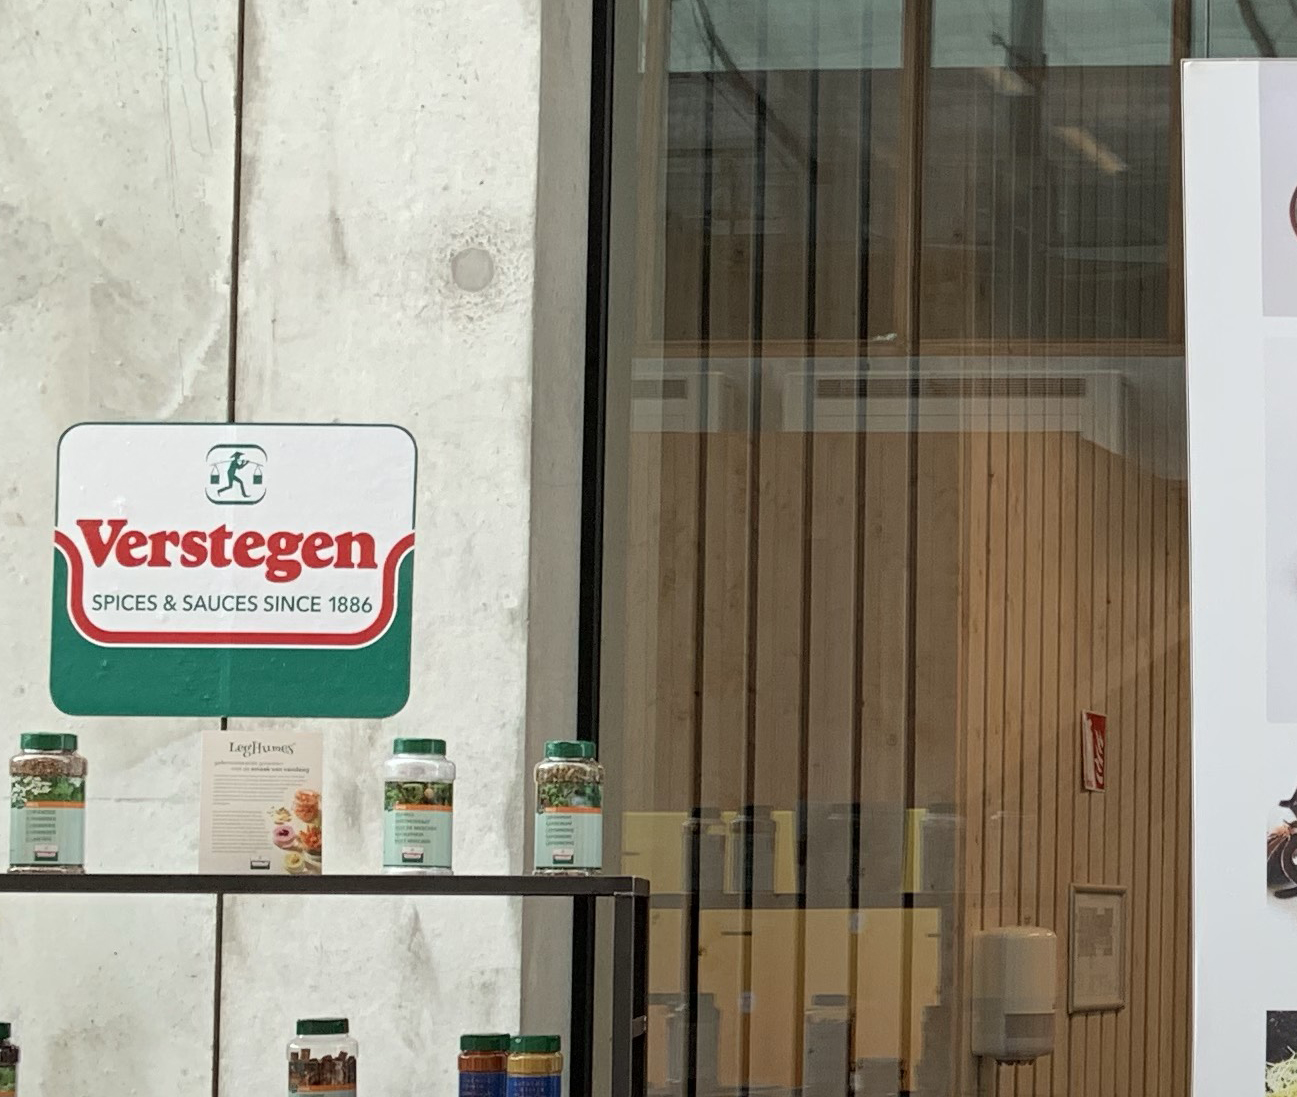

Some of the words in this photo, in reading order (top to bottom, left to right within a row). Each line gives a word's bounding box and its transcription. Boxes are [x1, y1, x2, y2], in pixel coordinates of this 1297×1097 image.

[76, 519, 378, 583] Verstegen
[92, 594, 158, 612] SPICES
[163, 594, 178, 612] &
[182, 594, 258, 613] SAUCES
[263, 595, 322, 613] SINCE
[328, 596, 373, 613] 1886
